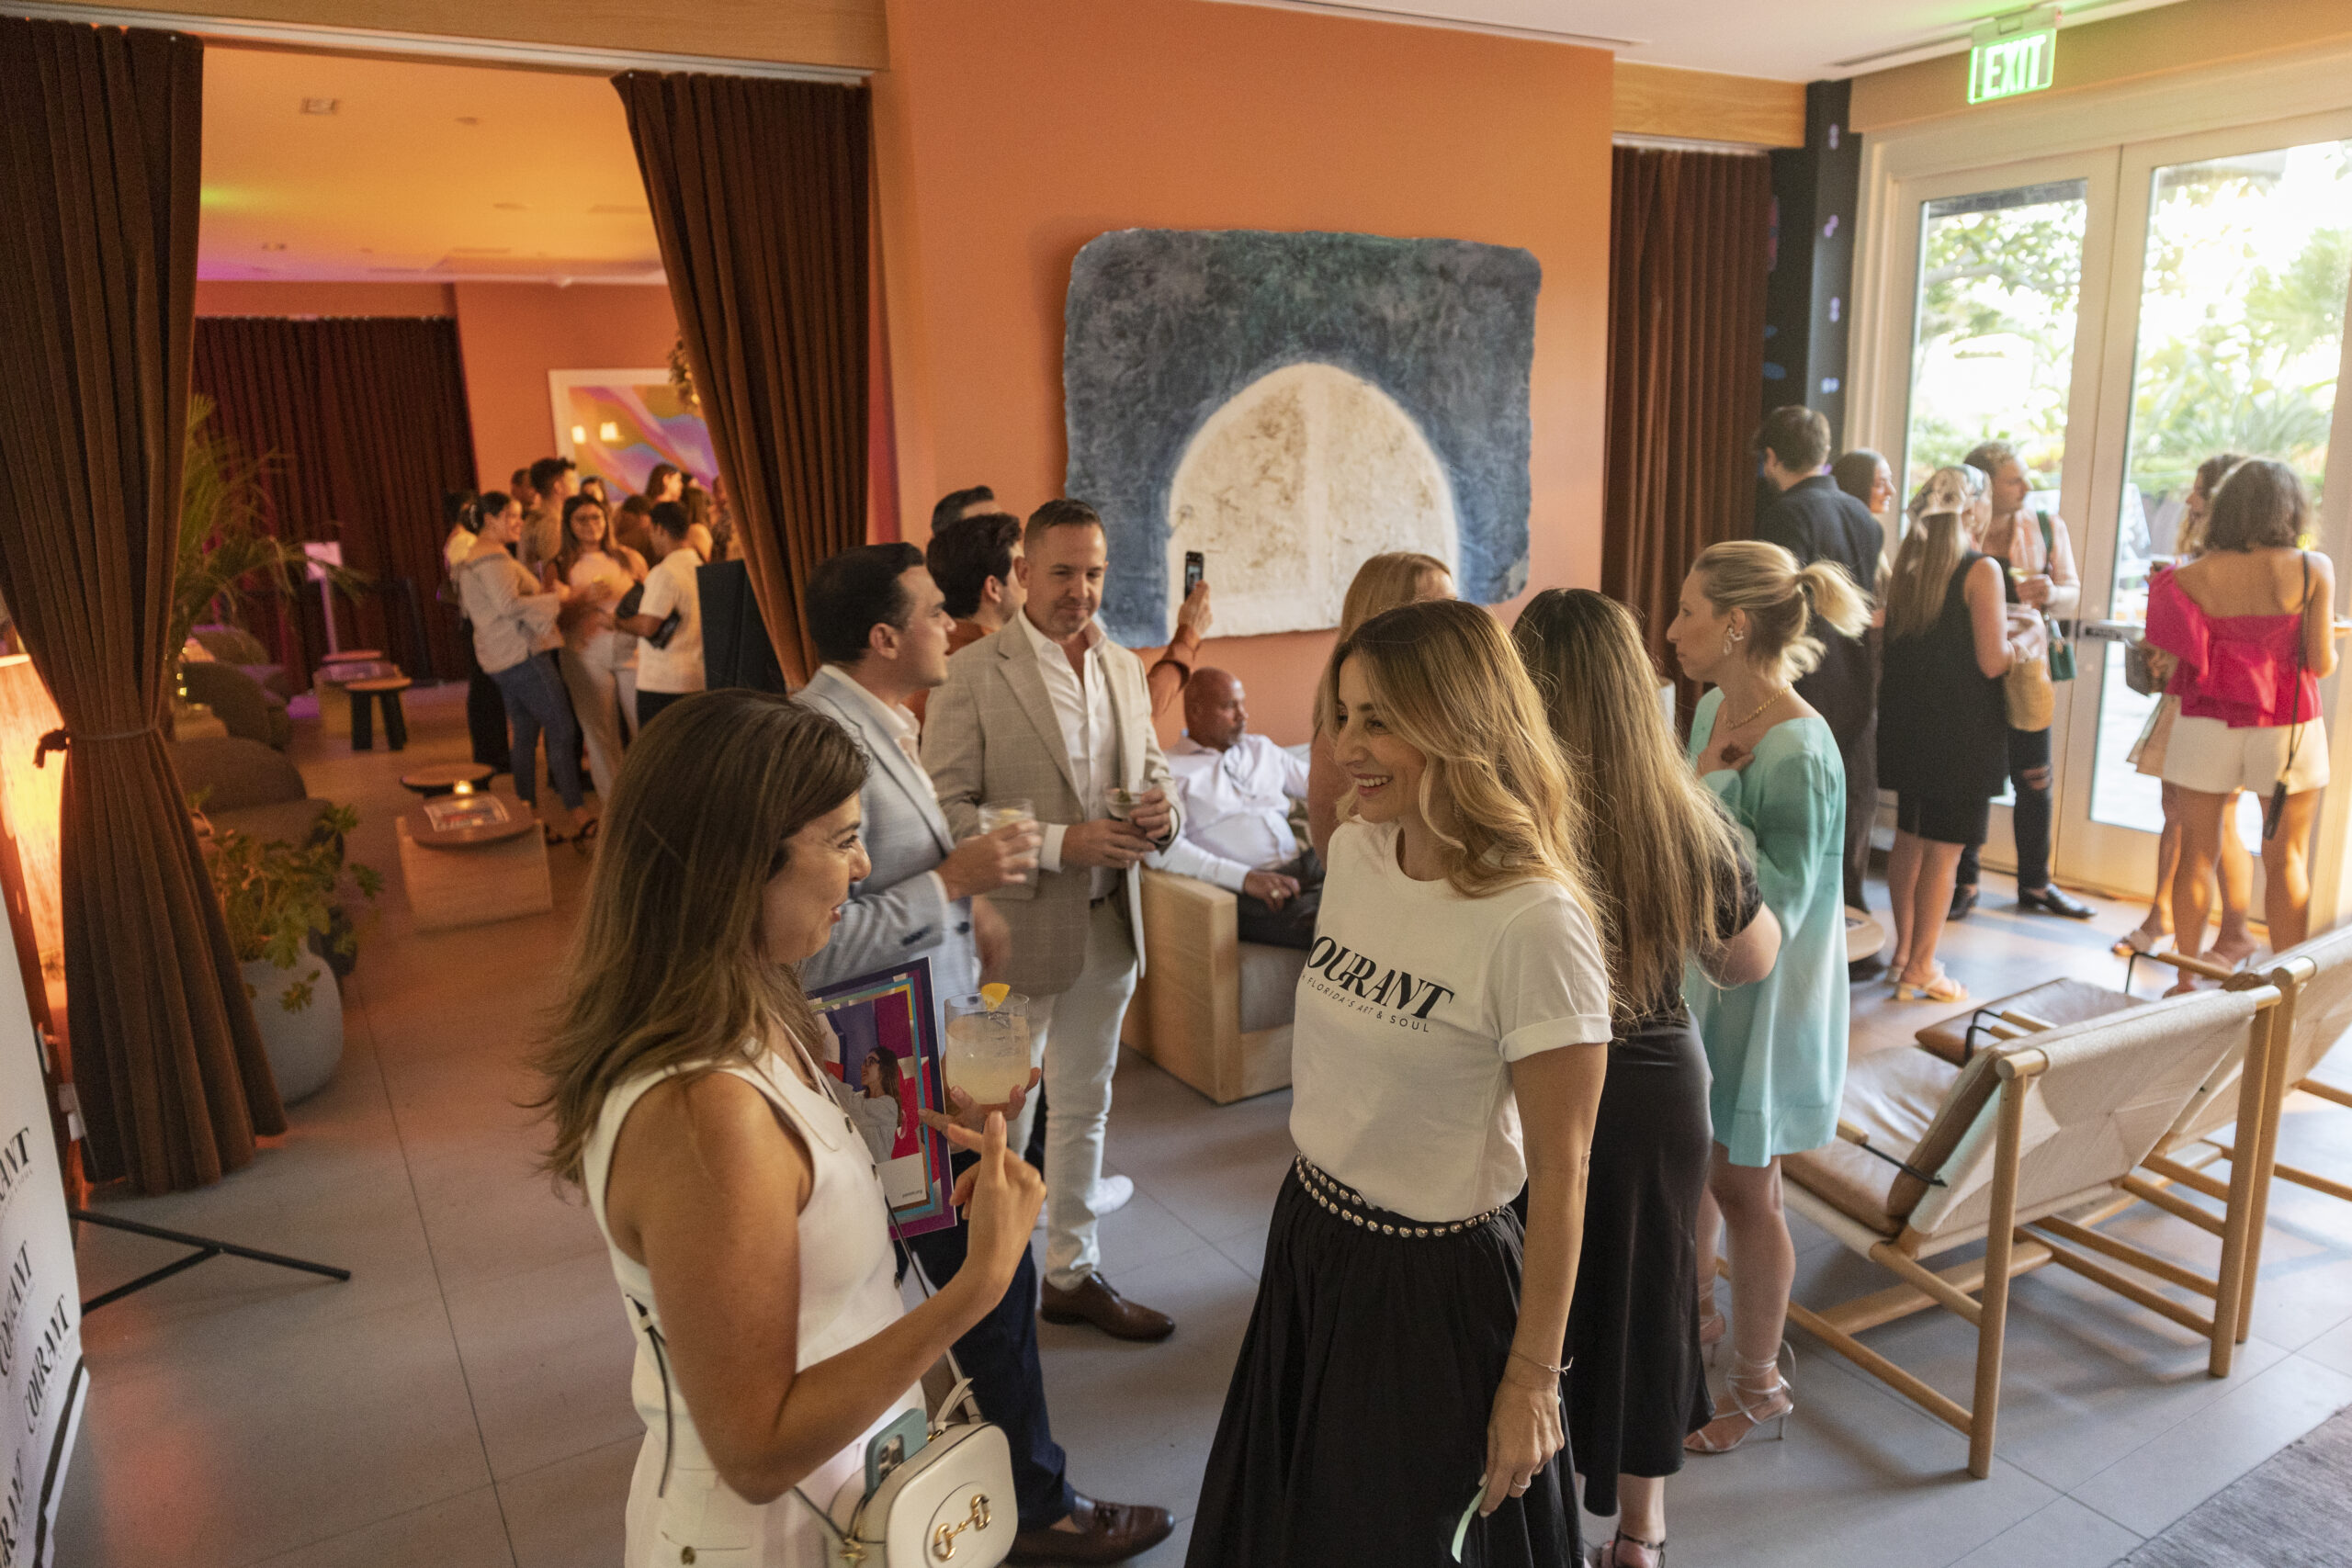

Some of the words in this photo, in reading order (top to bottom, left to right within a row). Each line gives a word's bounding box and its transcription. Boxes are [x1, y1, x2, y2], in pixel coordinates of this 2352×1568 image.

[1982, 34, 2046, 97] EXIT
[1307, 936, 1454, 1019] OURANT
[1308, 977, 1354, 1008] FLORIDA'S
[1357, 1005, 1374, 1015] ART
[1376, 1011, 1383, 1020] &
[1389, 1015, 1429, 1033] SOUL
[0, 1126, 29, 1201] ANT
[0, 1448, 23, 1567] RANT
